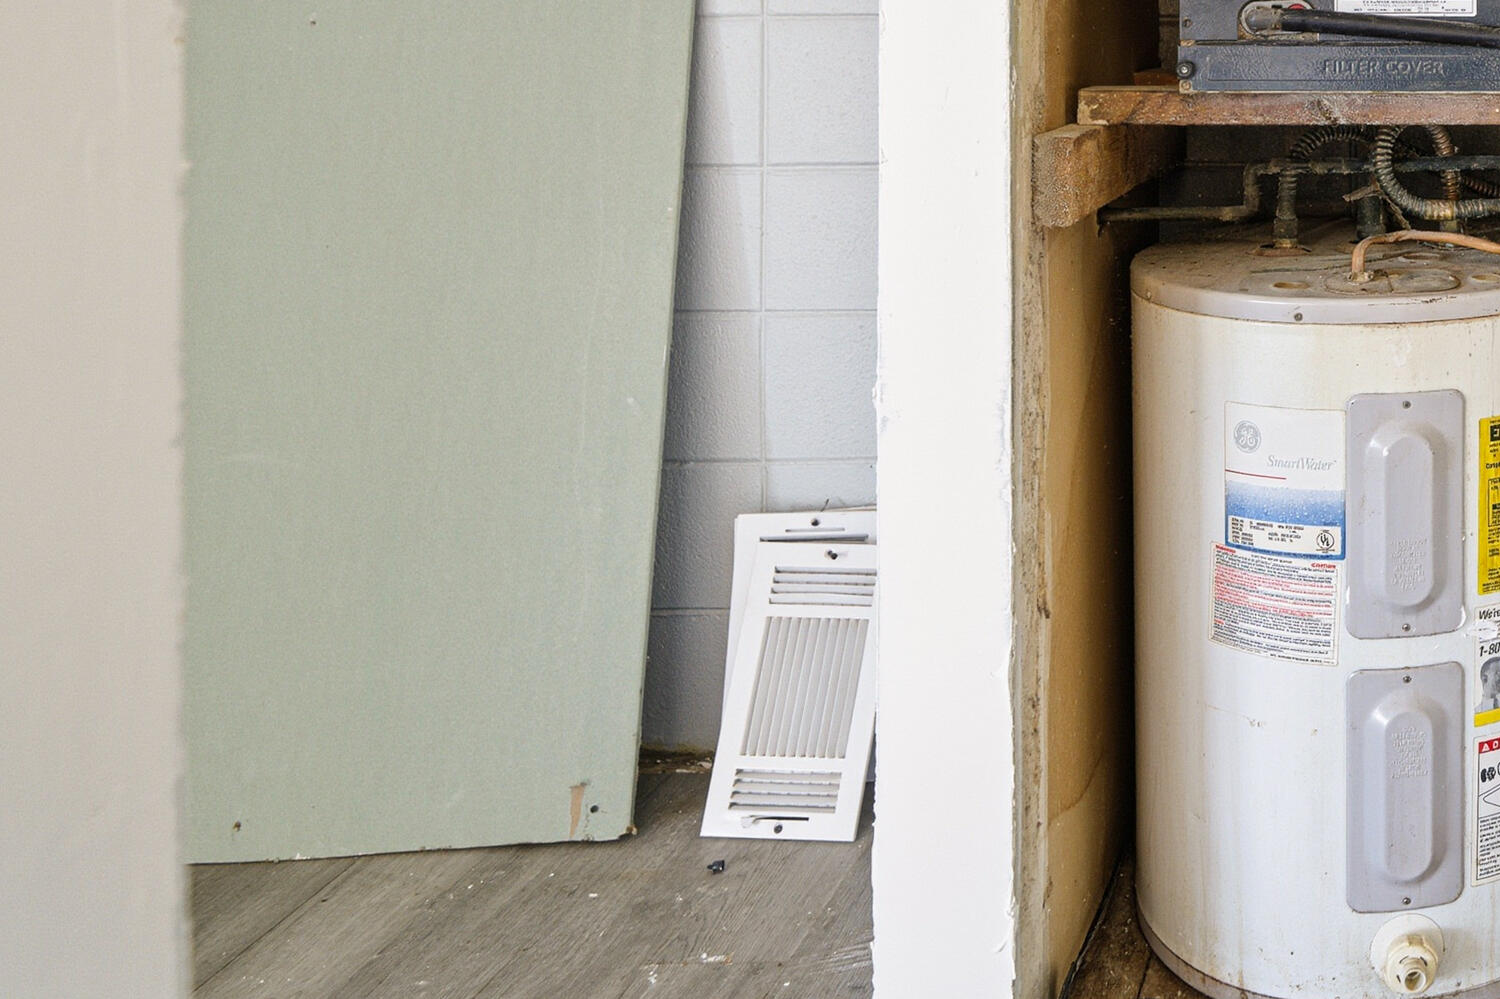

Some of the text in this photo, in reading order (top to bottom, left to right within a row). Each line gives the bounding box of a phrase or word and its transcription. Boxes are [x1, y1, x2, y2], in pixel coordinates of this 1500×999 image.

[1324, 59, 1446, 76] FILTER COVER
[1267, 454, 1333, 471] SmartWater
